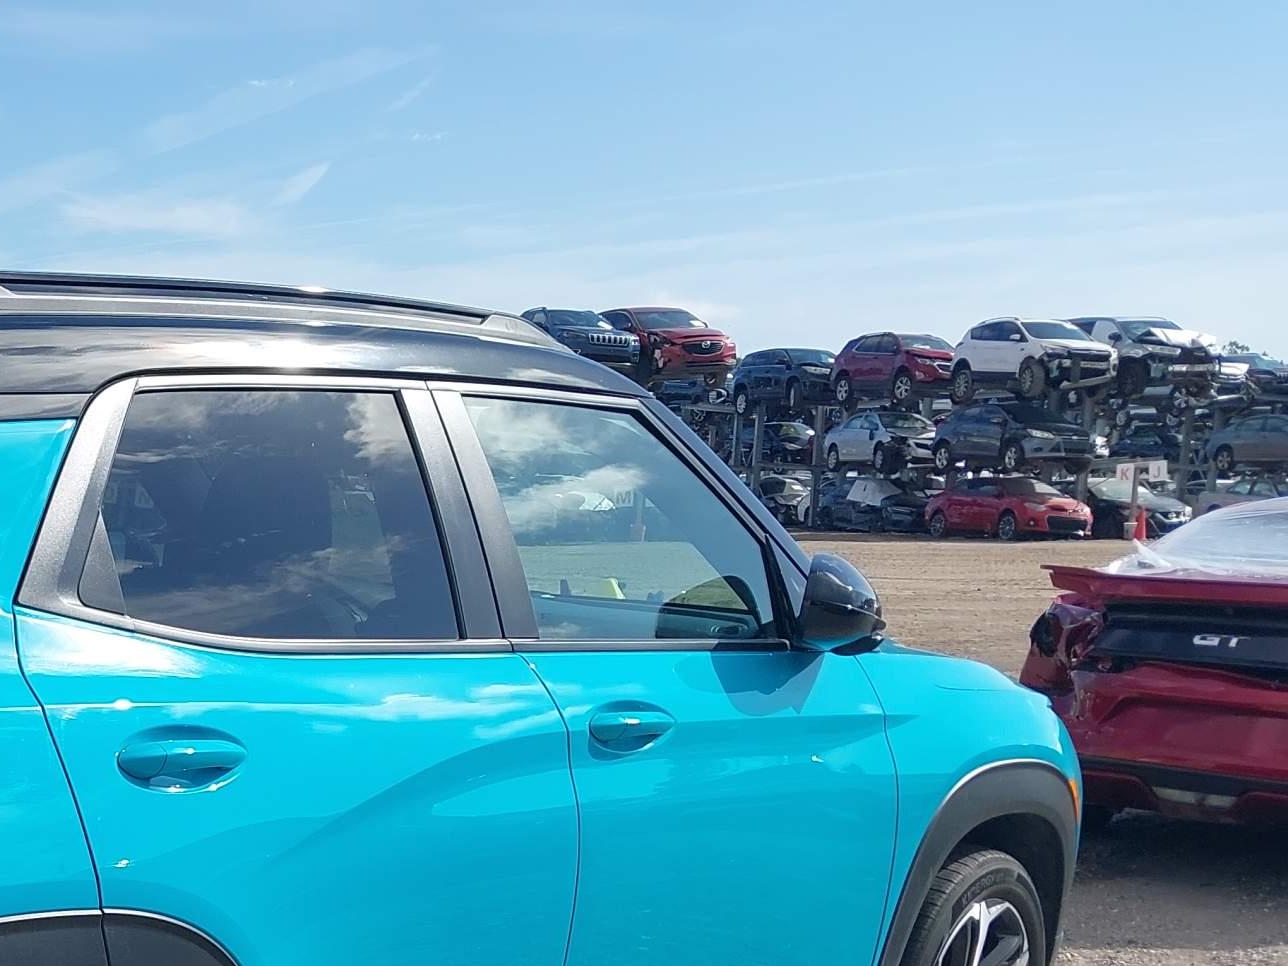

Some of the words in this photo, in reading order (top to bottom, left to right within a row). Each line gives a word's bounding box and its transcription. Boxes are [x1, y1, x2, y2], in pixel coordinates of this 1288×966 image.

[1120, 466, 1129, 480] K
[1152, 465, 1161, 478] J
[1193, 633, 1251, 648] GT
